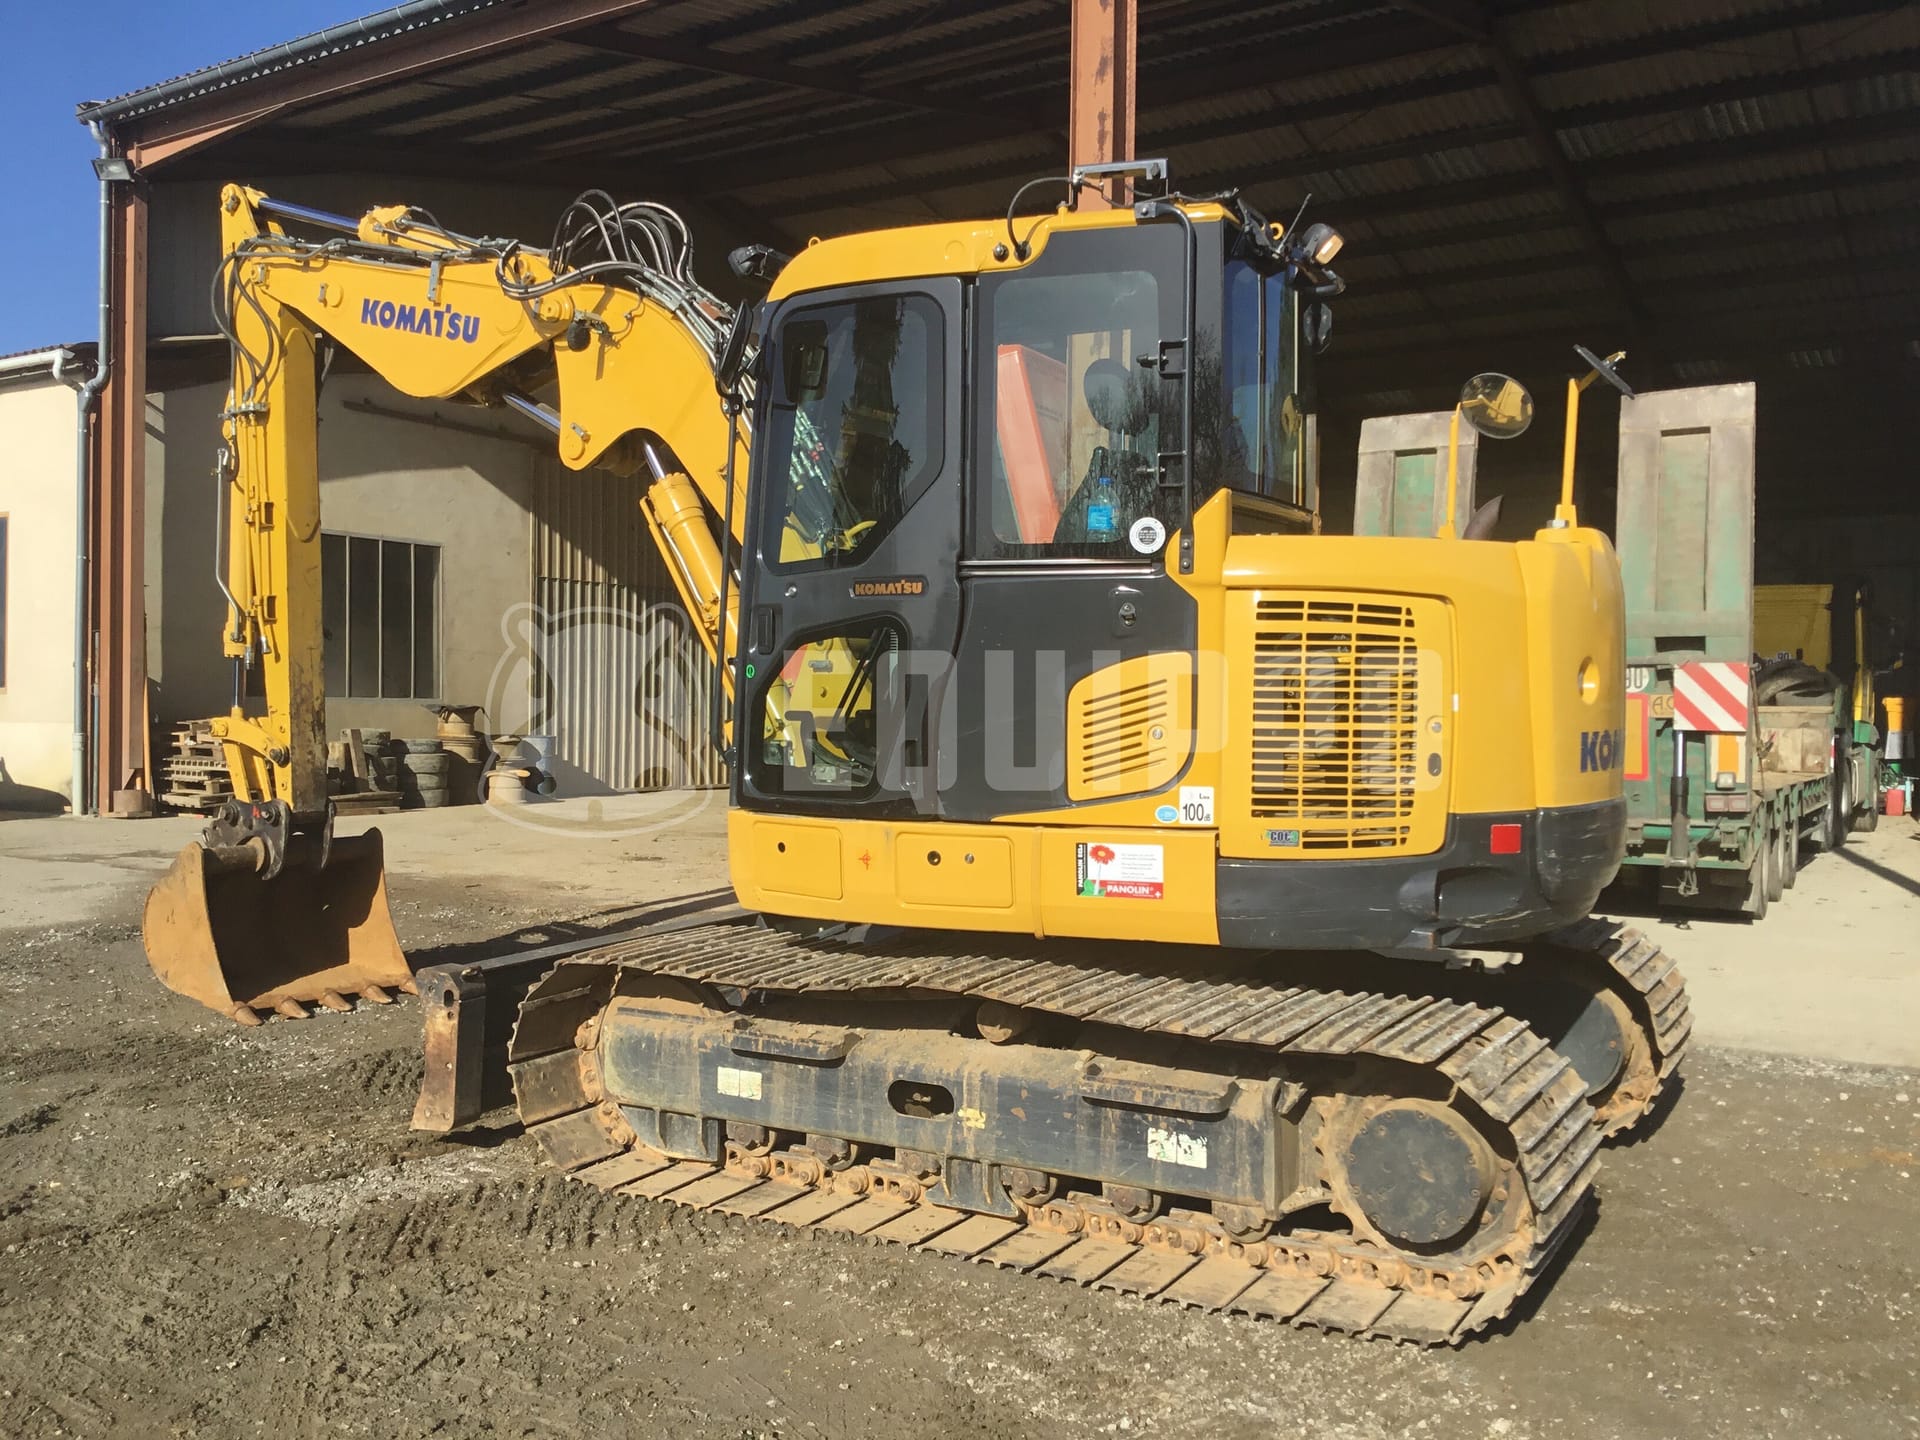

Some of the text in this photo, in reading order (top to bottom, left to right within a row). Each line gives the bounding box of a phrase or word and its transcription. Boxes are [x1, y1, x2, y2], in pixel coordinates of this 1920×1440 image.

[361, 298, 480, 343] KOMATSU
[855, 579, 923, 595] KOMATSU
[1182, 803, 1204, 821] 100
[1106, 885, 1150, 895] PANOLIN
